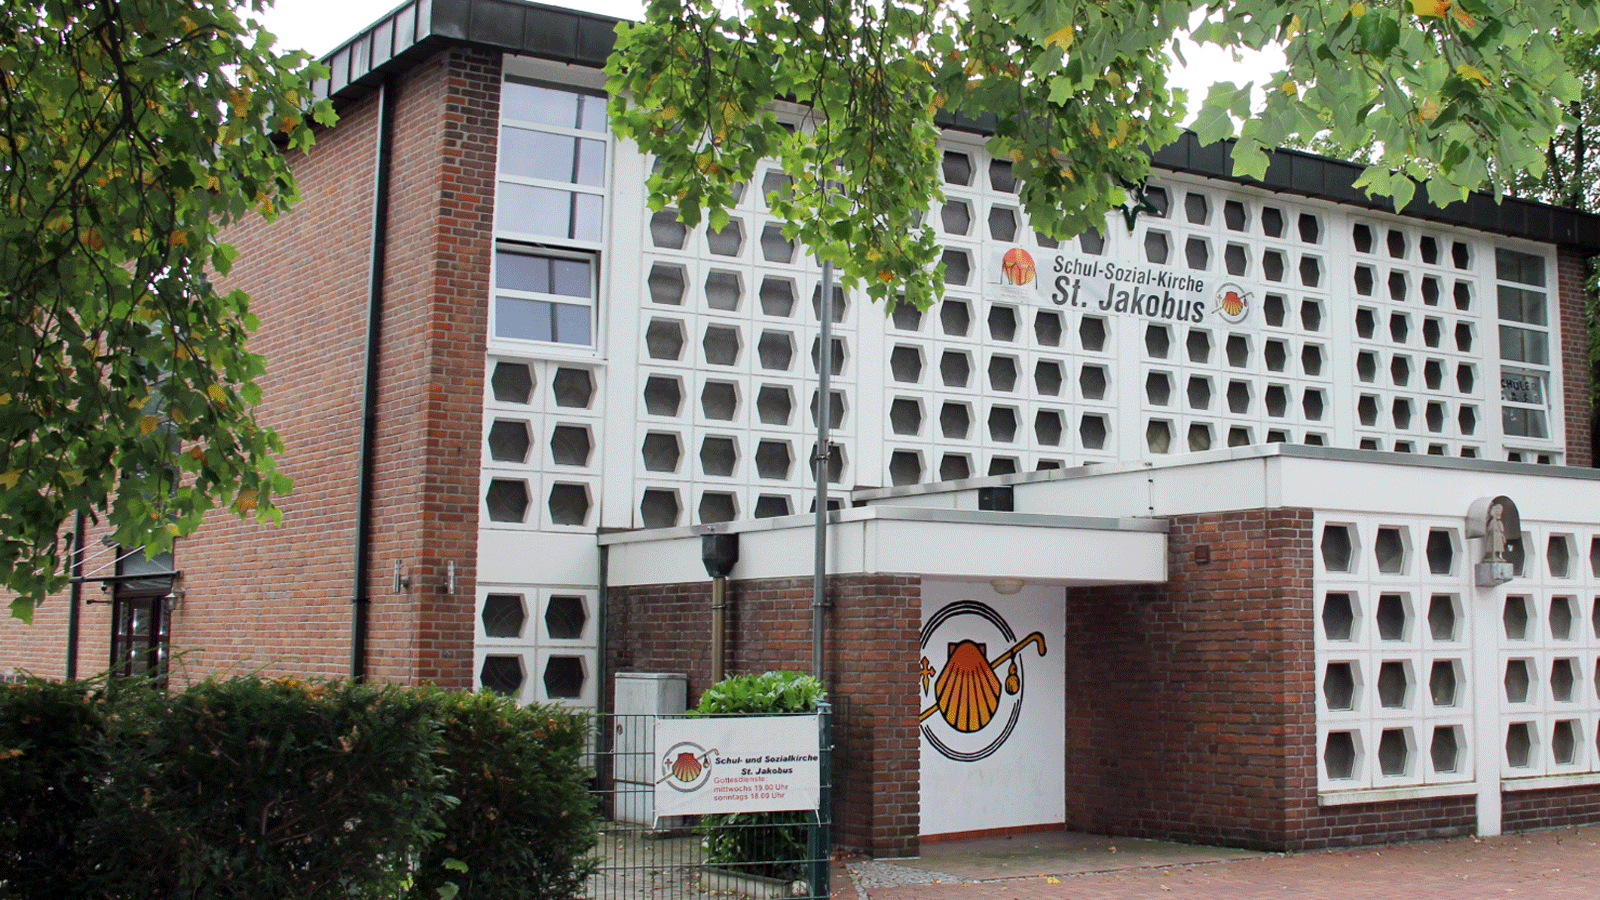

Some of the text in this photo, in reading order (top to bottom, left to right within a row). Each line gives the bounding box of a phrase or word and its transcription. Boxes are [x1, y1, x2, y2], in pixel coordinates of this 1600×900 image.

[1053, 255, 1204, 293] Schul-Sozial-Kirche
[1052, 275, 1205, 323] St. Jakobus
[715, 754, 818, 765] Schul- und Sozialkirche
[755, 767, 793, 775] Jakobus
[714, 785, 752, 793] mittwochs
[775, 783, 788, 791] Uhr
